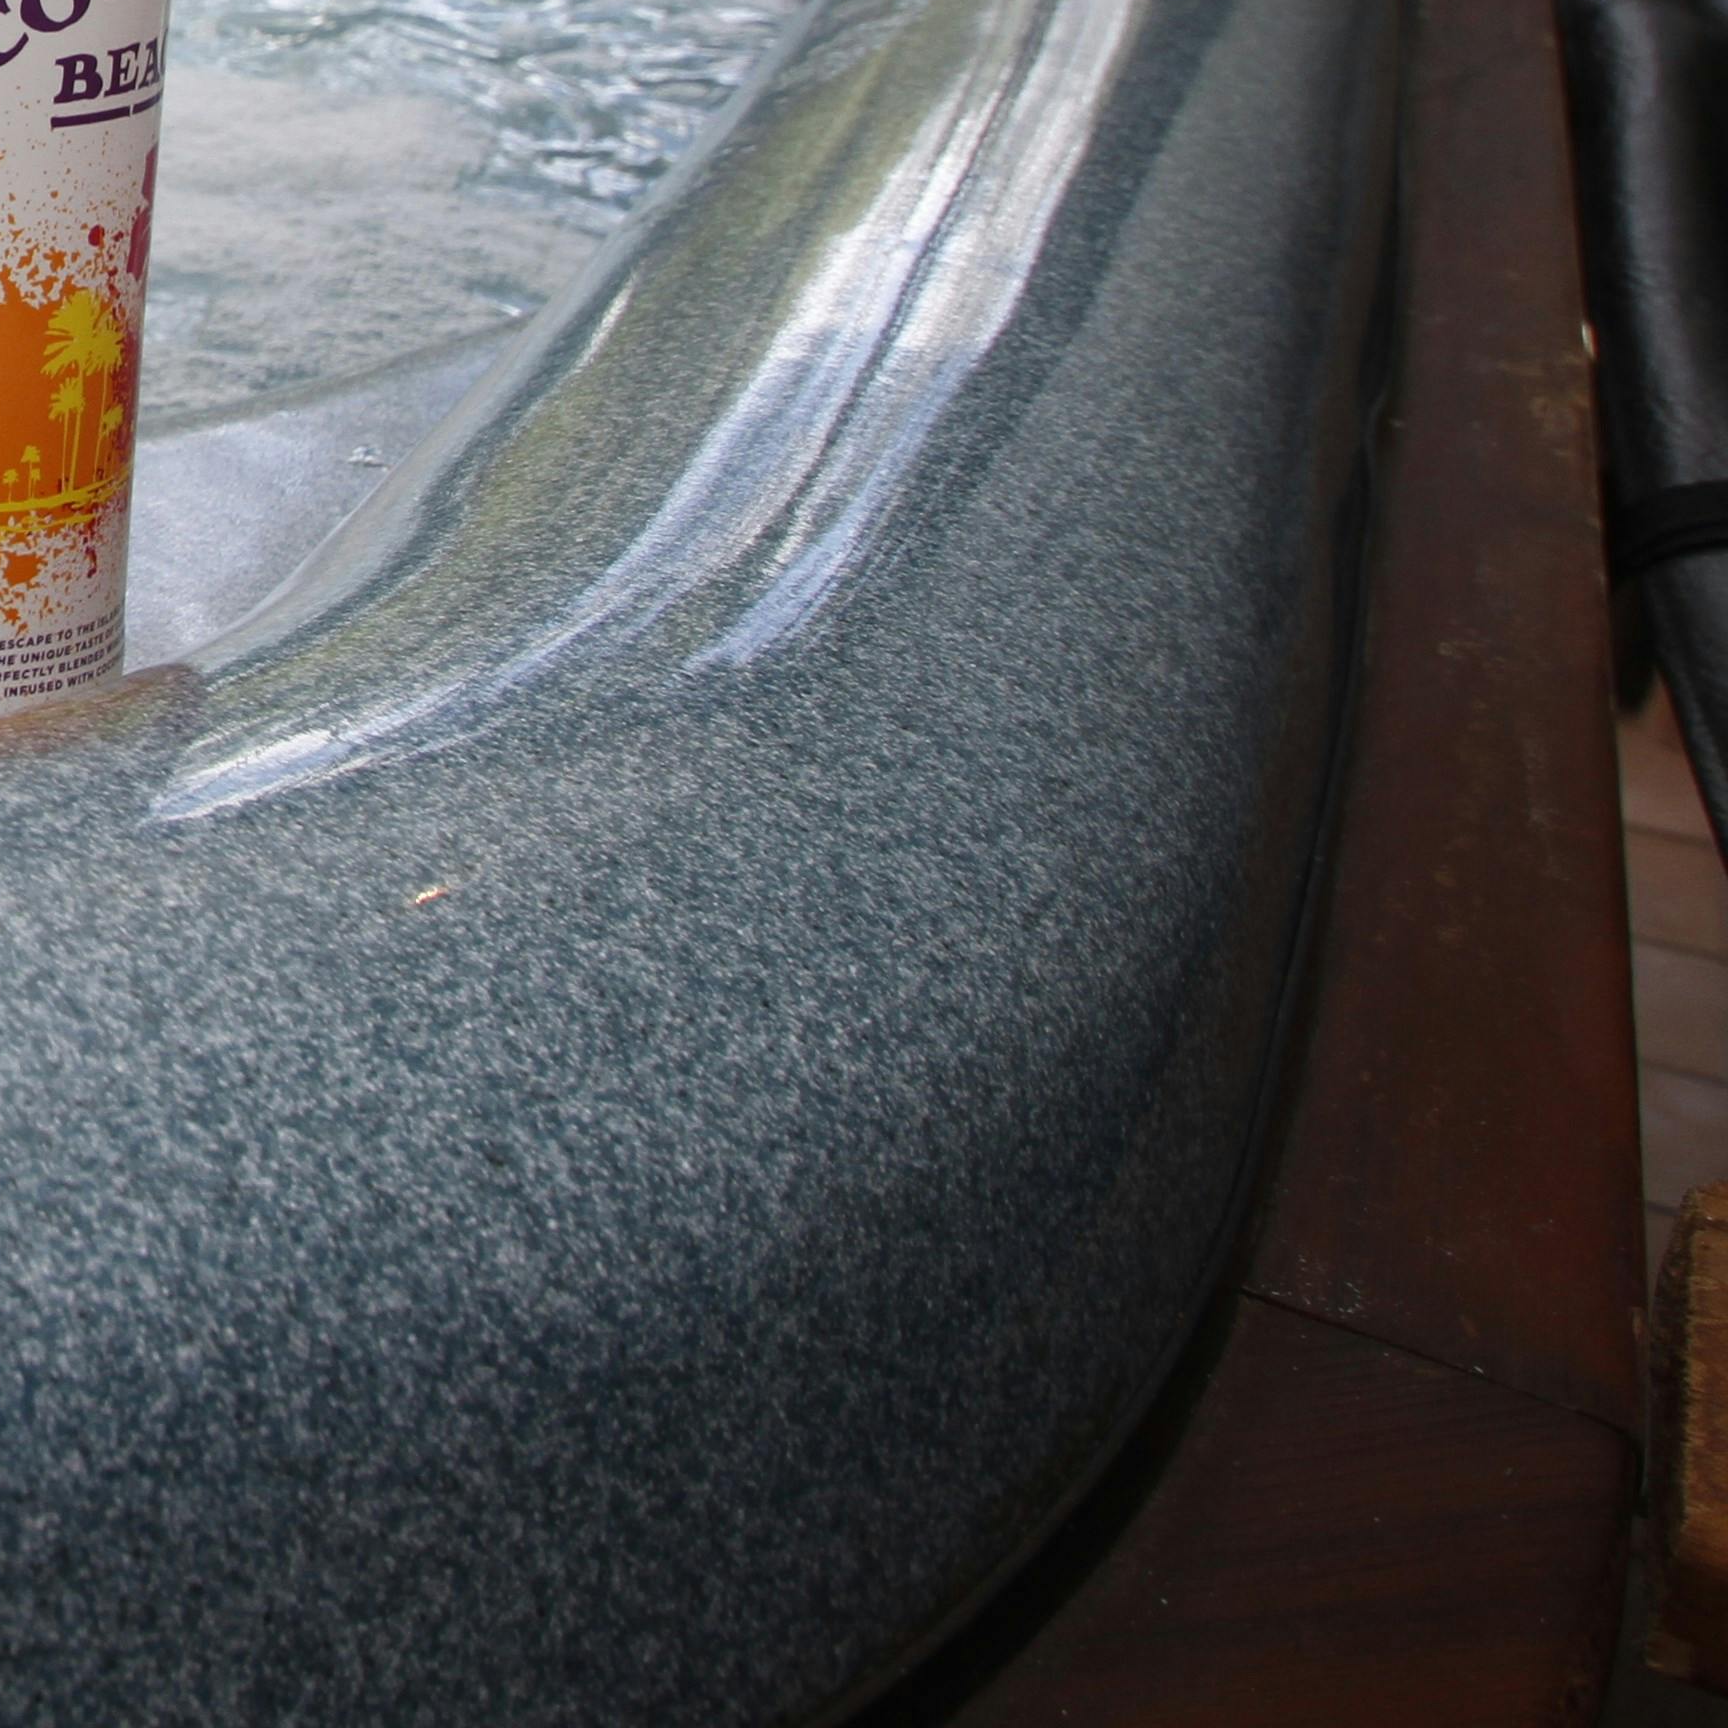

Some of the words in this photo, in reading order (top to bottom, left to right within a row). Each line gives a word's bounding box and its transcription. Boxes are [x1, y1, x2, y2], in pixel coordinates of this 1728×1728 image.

[57, 628, 73, 642] TO
[77, 620, 96, 636] THE
[20, 646, 71, 664] UNIQUE
[74, 632, 104, 653] TASTE
[58, 648, 105, 673] BLENDED
[3, 679, 63, 698] INFUSED
[67, 669, 95, 687] WITH
